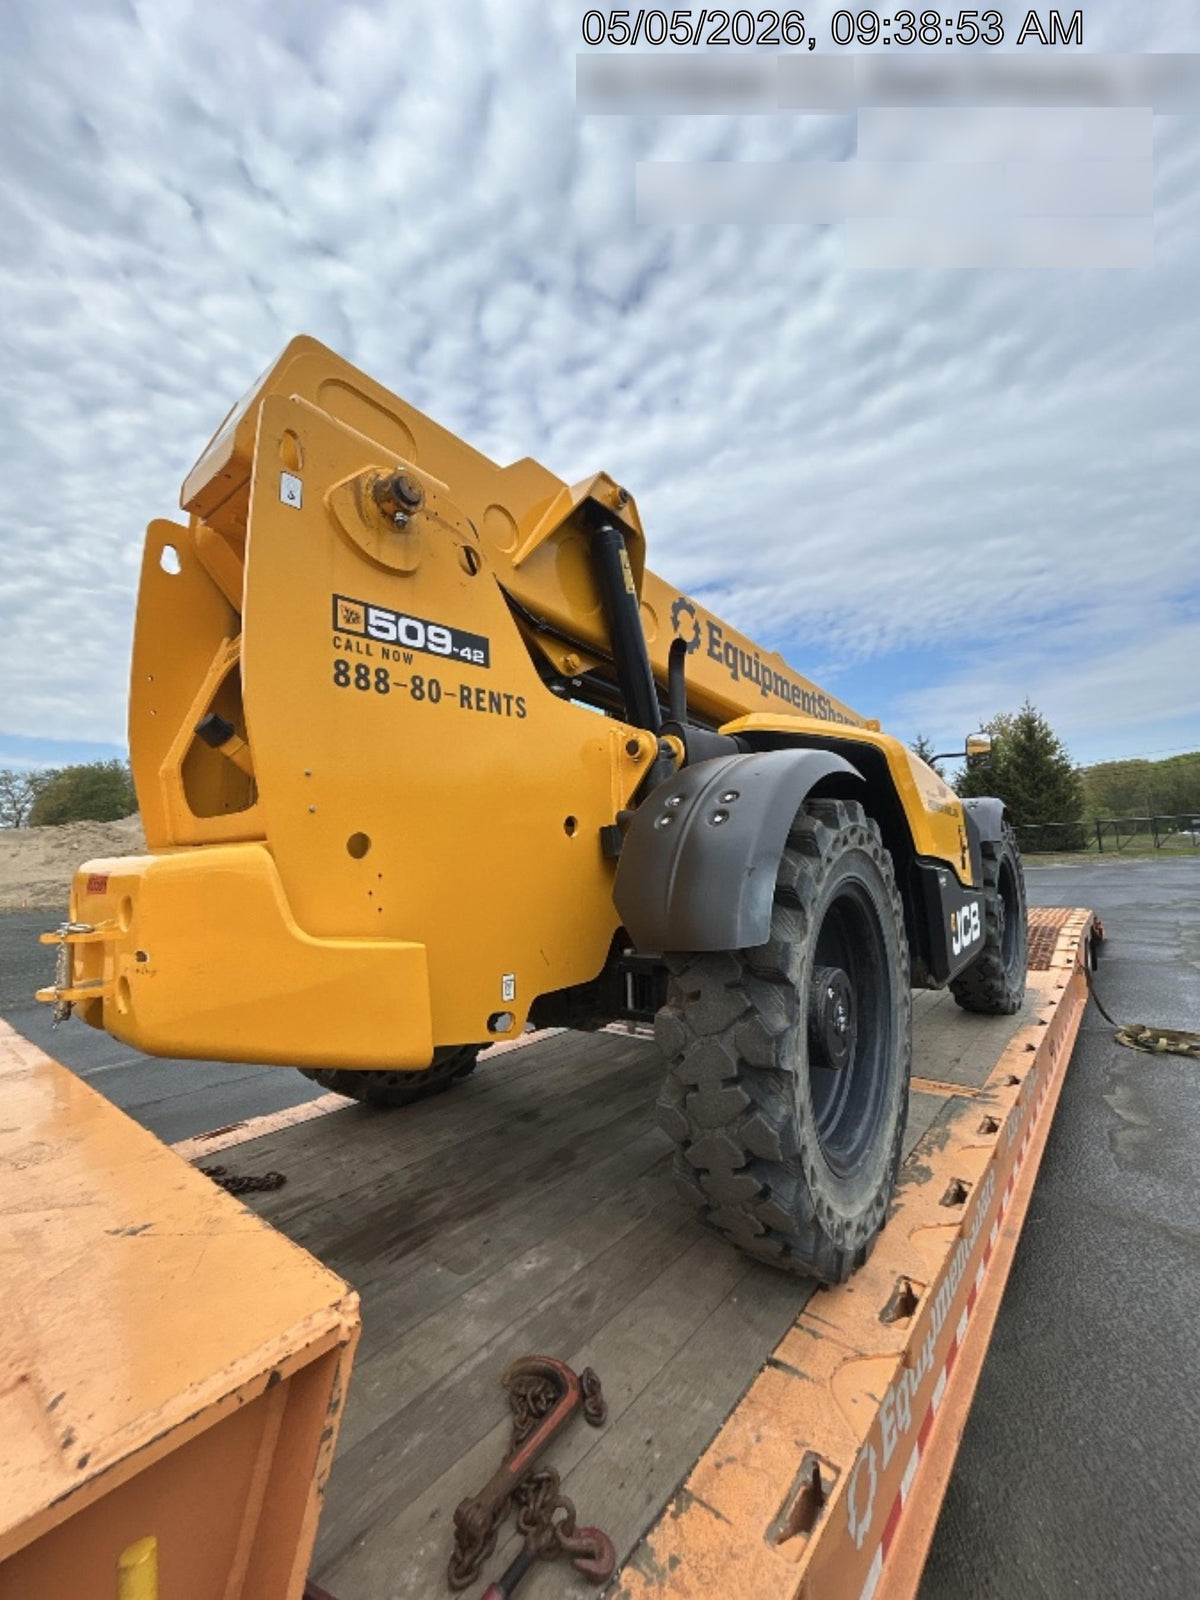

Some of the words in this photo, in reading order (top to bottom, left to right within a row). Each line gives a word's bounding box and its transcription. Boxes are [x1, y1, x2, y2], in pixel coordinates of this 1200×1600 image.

[333, 636, 374, 657] CALL
[382, 647, 414, 665] NOW
[367, 607, 485, 664] 509-42
[333, 659, 527, 719] 888-80-RENTS
[951, 901, 981, 956] JCB
